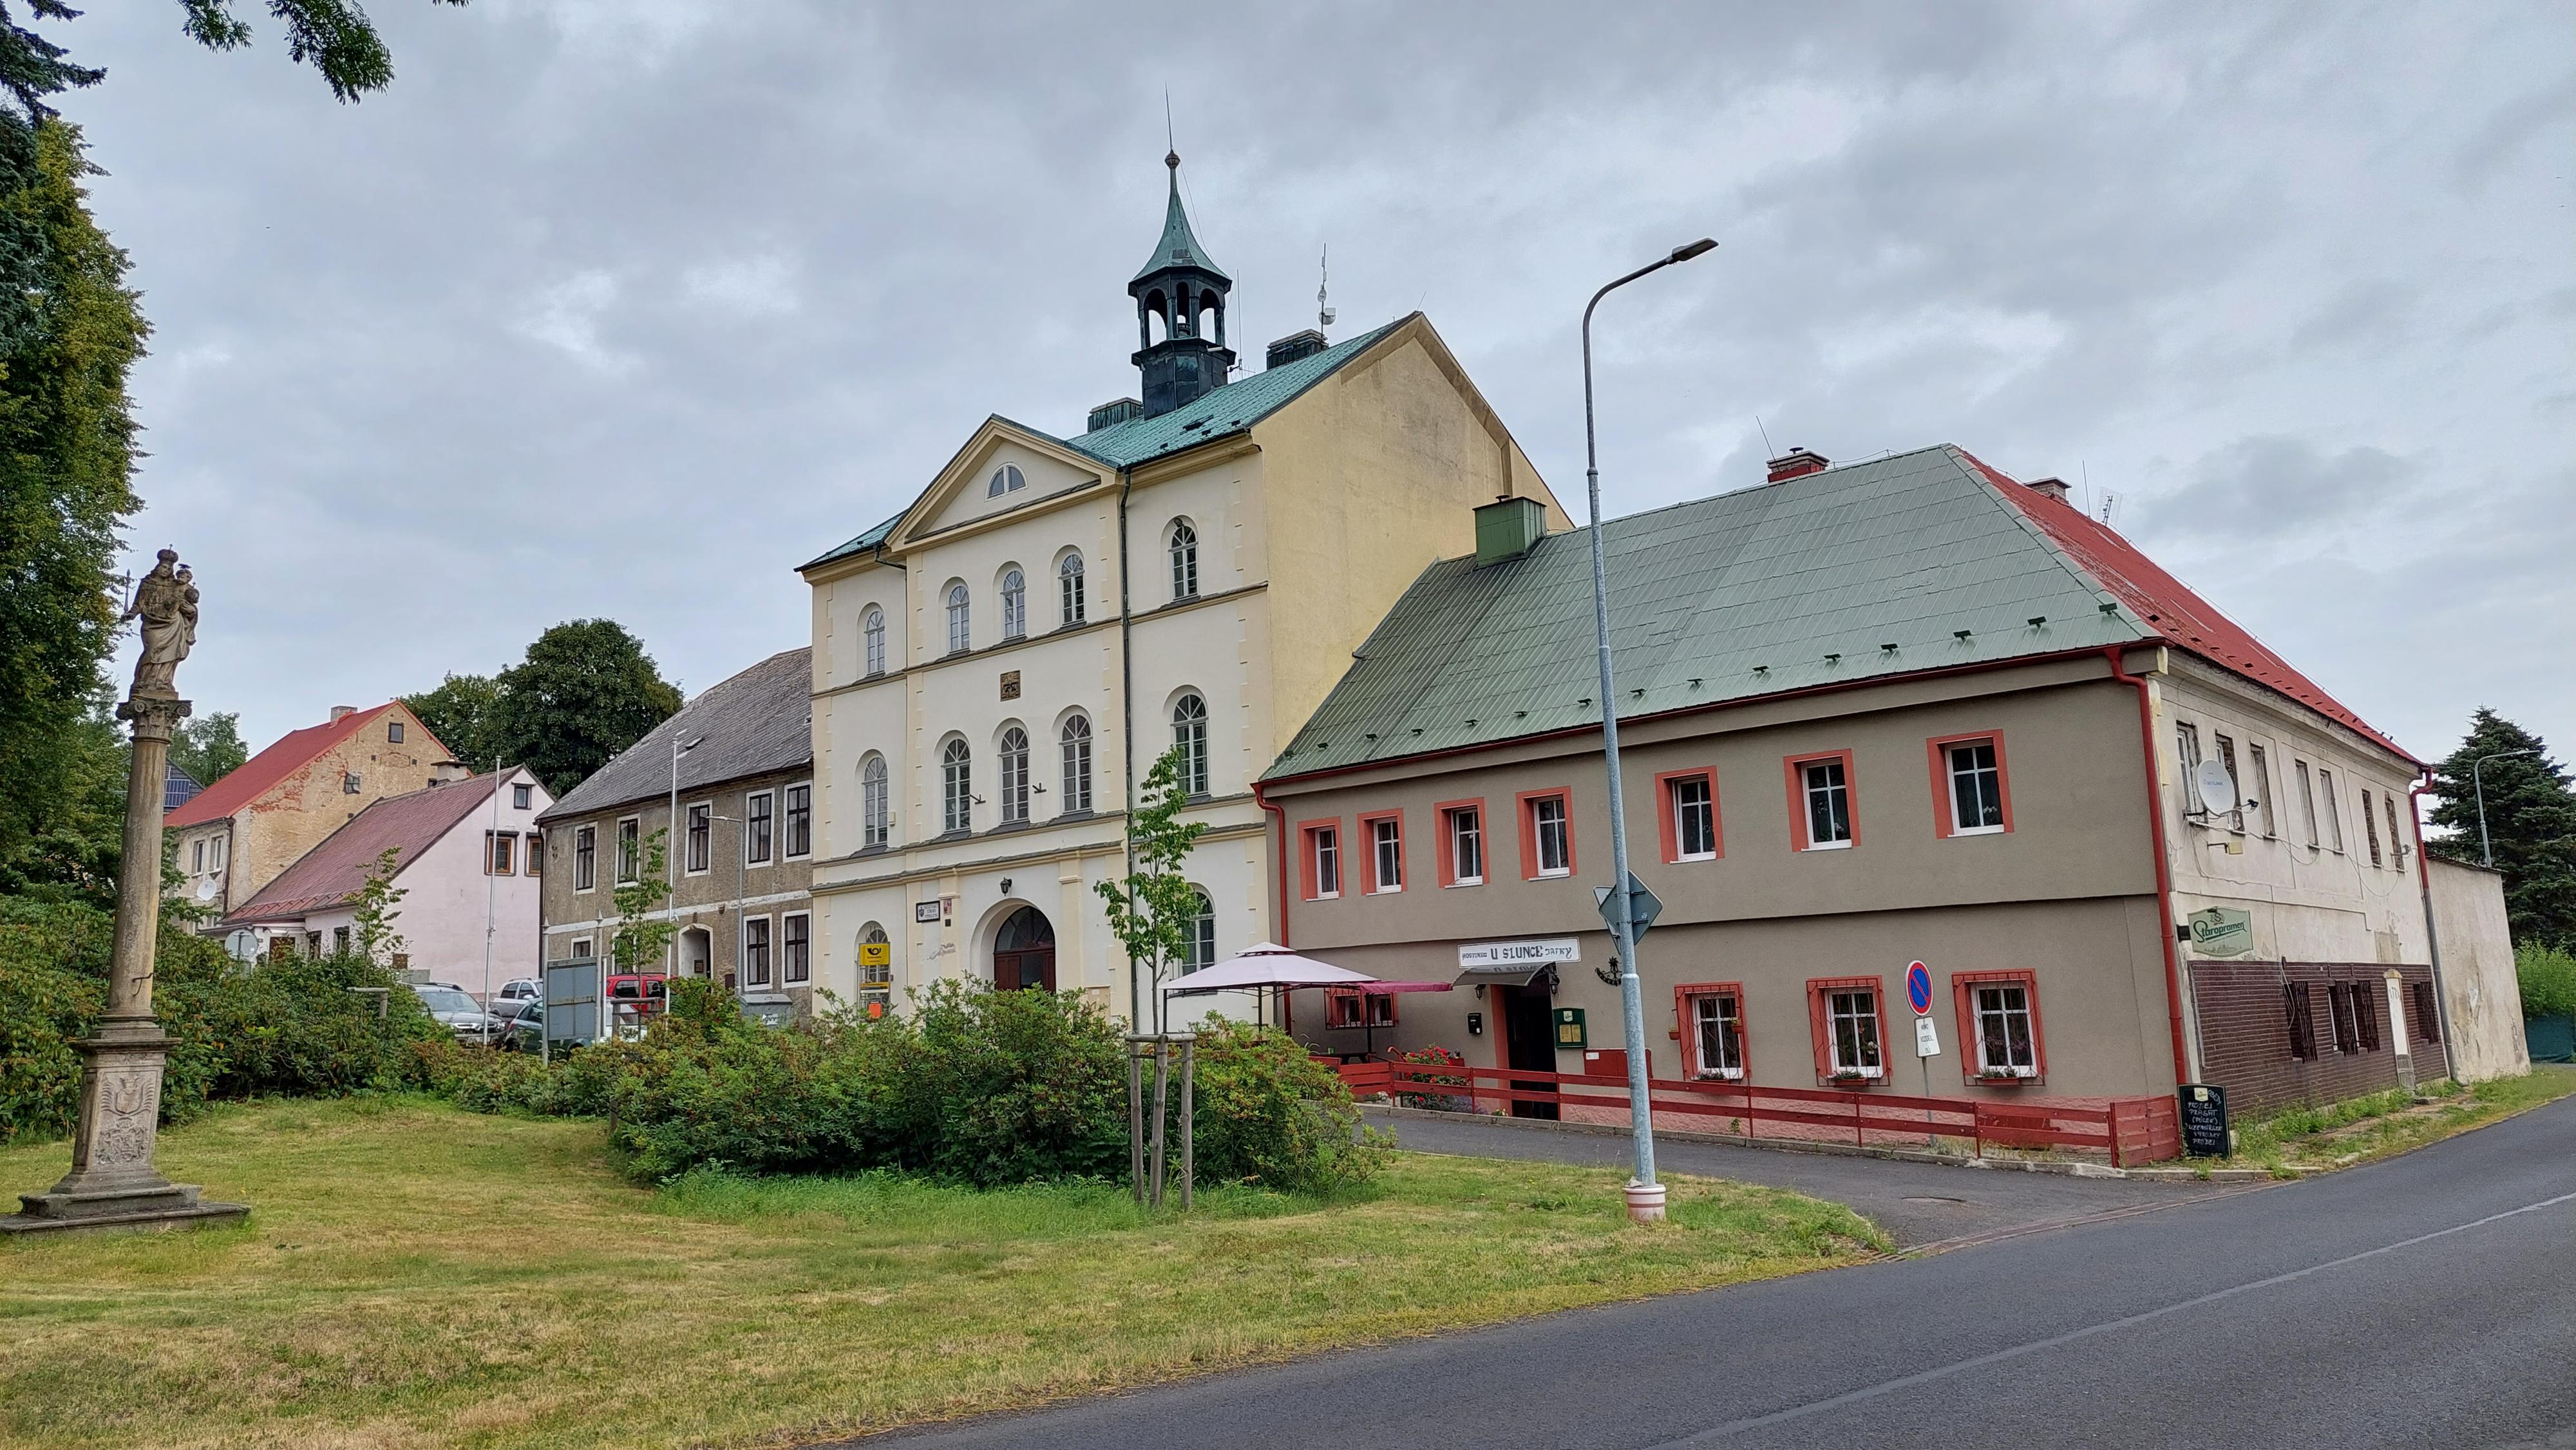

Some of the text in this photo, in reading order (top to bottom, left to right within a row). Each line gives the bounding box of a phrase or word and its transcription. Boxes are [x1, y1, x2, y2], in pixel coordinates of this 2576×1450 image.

[2193, 920, 2247, 943] Staropramen
[1490, 948, 1499, 960] U
[1502, 945, 1543, 959] SLUNCE
